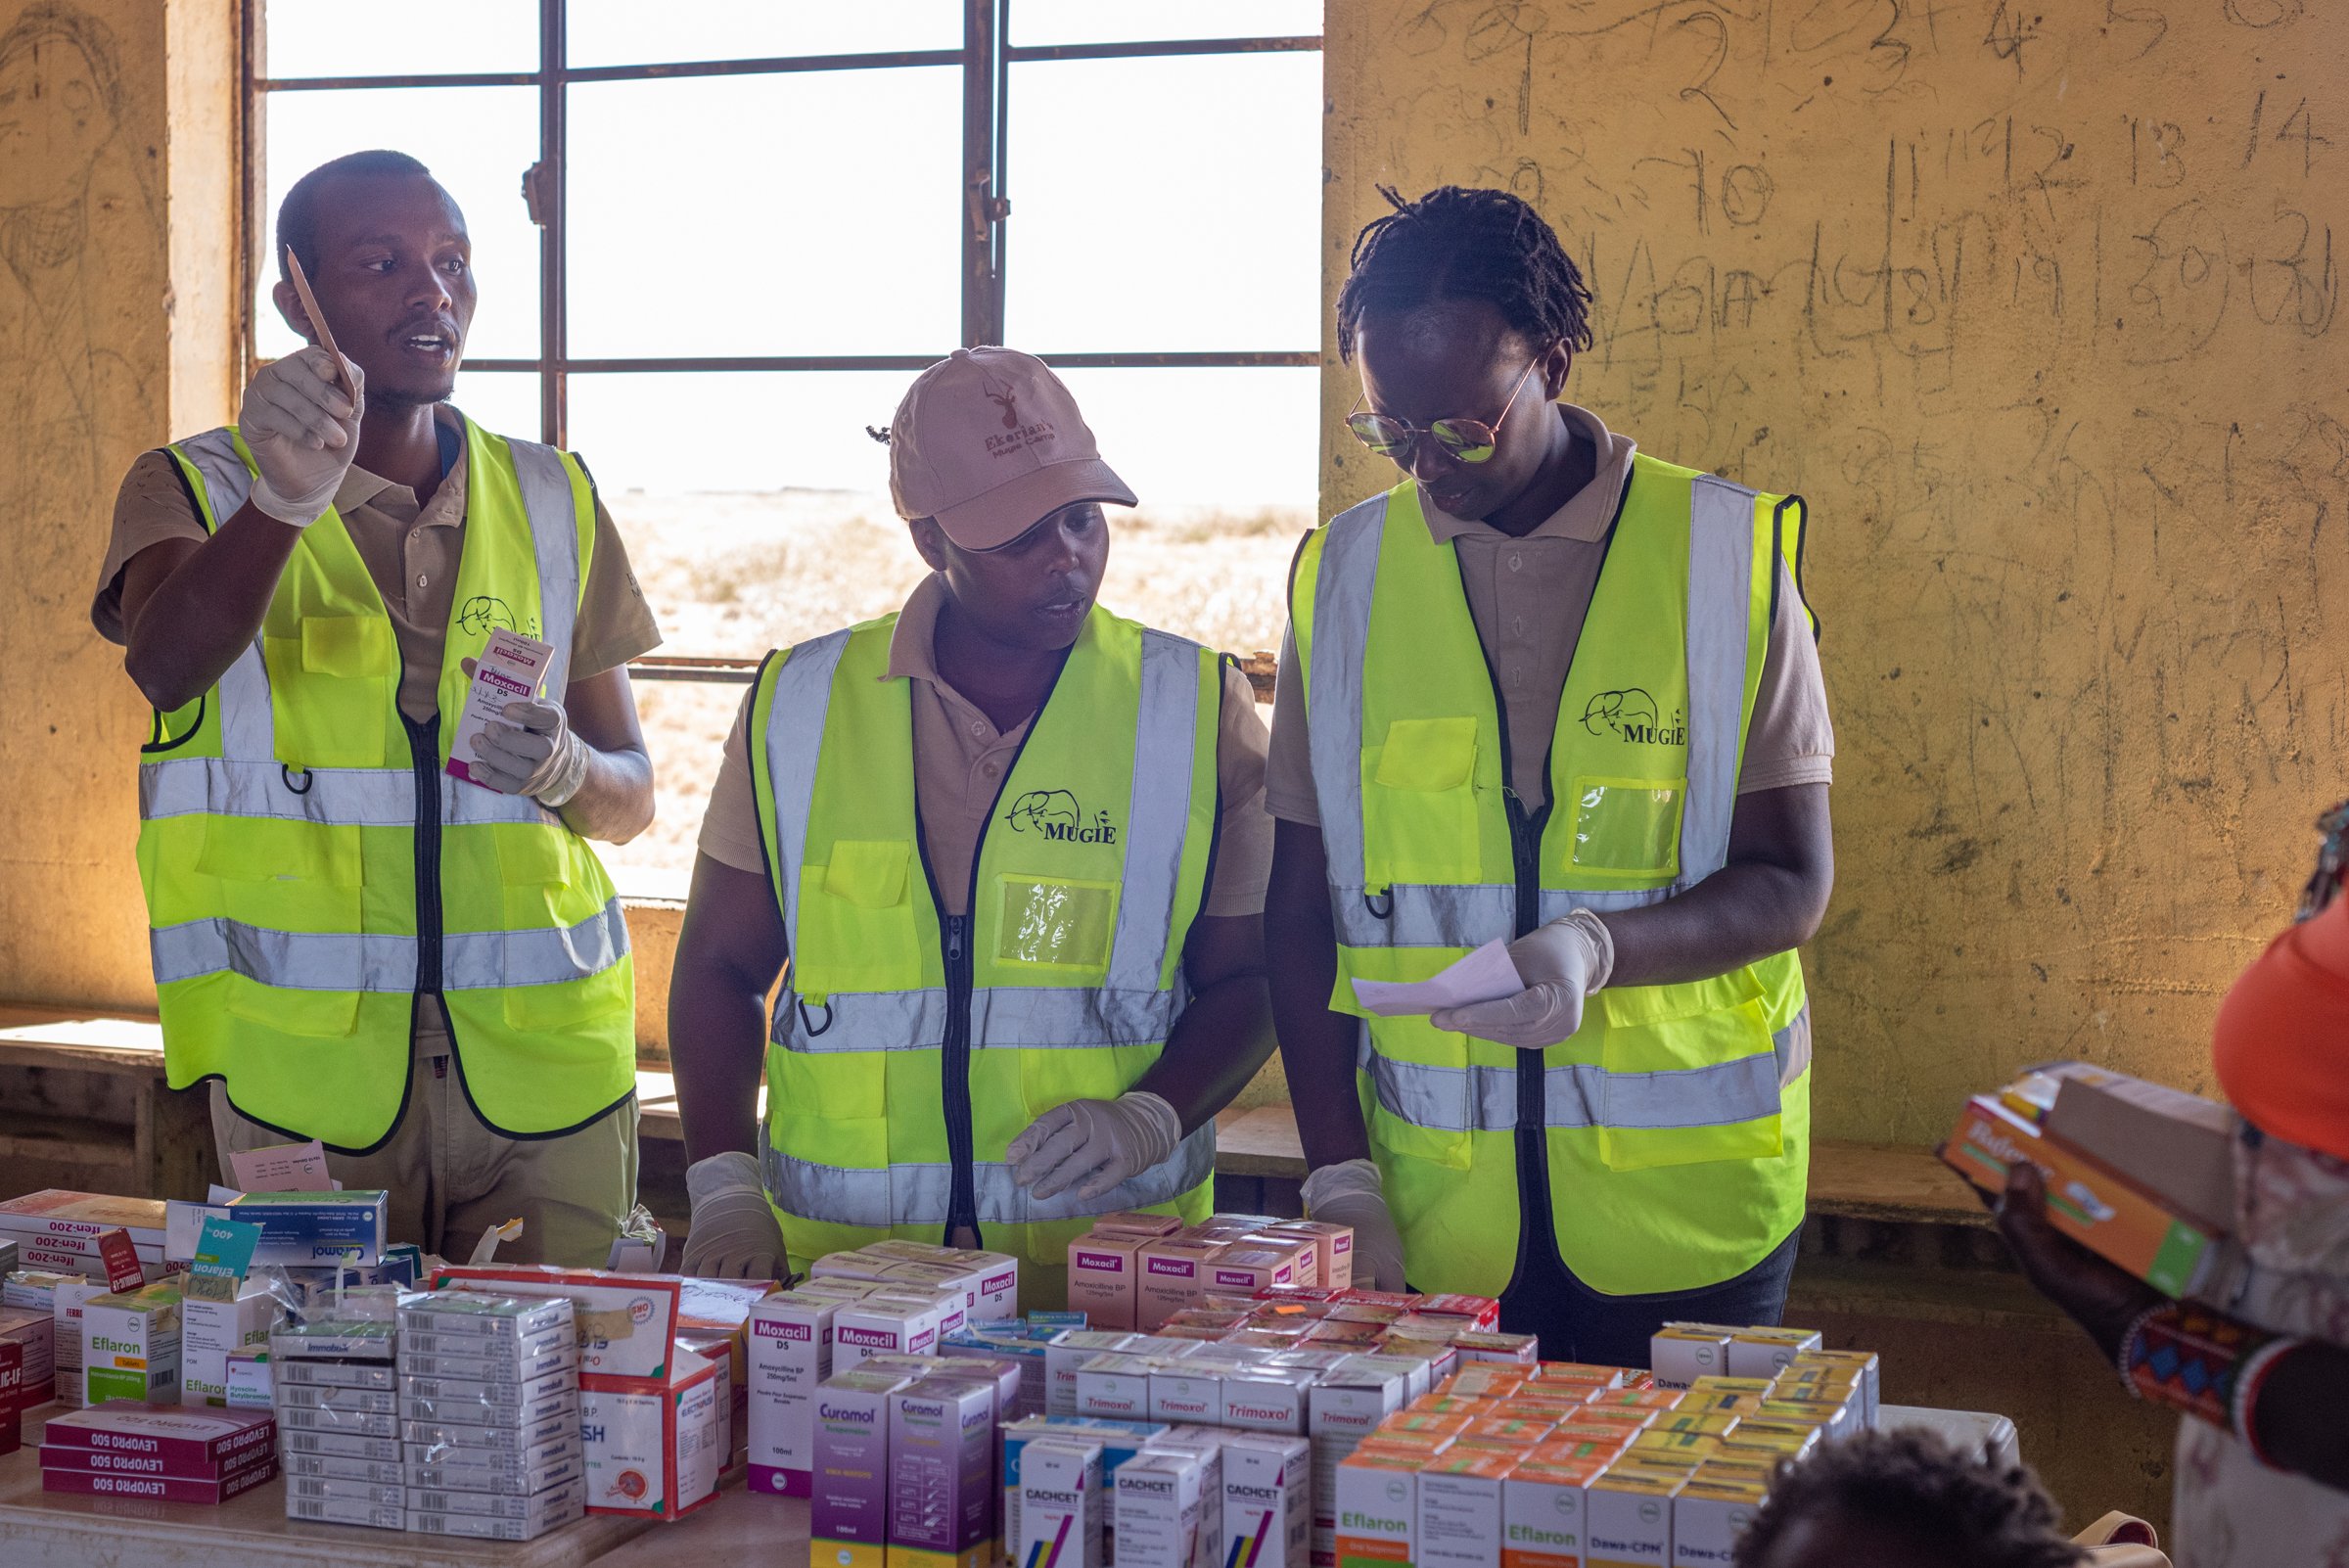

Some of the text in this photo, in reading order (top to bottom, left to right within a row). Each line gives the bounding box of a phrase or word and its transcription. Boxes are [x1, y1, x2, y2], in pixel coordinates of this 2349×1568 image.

[483, 672, 528, 695] Moxacil
[496, 688, 508, 697] DS
[1624, 724, 1685, 745] MUGIE
[1044, 822, 1117, 845] MUGIE
[194, 1264, 235, 1276] Eflaron
[1081, 1257, 1117, 1269] Moxacil
[1153, 1262, 1189, 1275] Moxacil
[984, 1273, 1014, 1294] Moxacil
[1220, 1274, 1250, 1285] Moxacil
[994, 1292, 1002, 1302] DS
[245, 1329, 269, 1345] Eflar
[758, 1321, 808, 1339] Moxacil
[92, 1337, 140, 1354] Eflaron
[776, 1340, 789, 1351] DS
[842, 1329, 894, 1348] Moxacil
[860, 1349, 874, 1358] DS
[1057, 1371, 1076, 1382] Trim
[1658, 1378, 1691, 1390] Dawa-
[900, 1400, 944, 1417] Curamol
[1087, 1398, 1133, 1410] Trimoxol
[1159, 1400, 1206, 1413] Trimoxol
[820, 1404, 875, 1423] Curamol
[1227, 1405, 1290, 1421] Trimoxol
[1323, 1412, 1369, 1426] Trimoxol
[91, 1433, 158, 1453] LEVOPRO 500
[217, 1425, 269, 1454] LEVOPRO 500
[771, 1447, 793, 1456] 100ml
[90, 1454, 163, 1472] LEVOPRO 500
[224, 1457, 237, 1472] 500
[94, 1478, 165, 1496] LEVOPRO 500
[226, 1464, 270, 1496] LEVOPRO 500
[1119, 1479, 1174, 1494] CACHCET
[1026, 1490, 1079, 1503] CACHCET
[1226, 1484, 1279, 1499] CACHCET
[1342, 1511, 1407, 1533] Eflaron
[1509, 1524, 1576, 1546] Eflaron
[1590, 1537, 1662, 1554] Dawa-CPM
